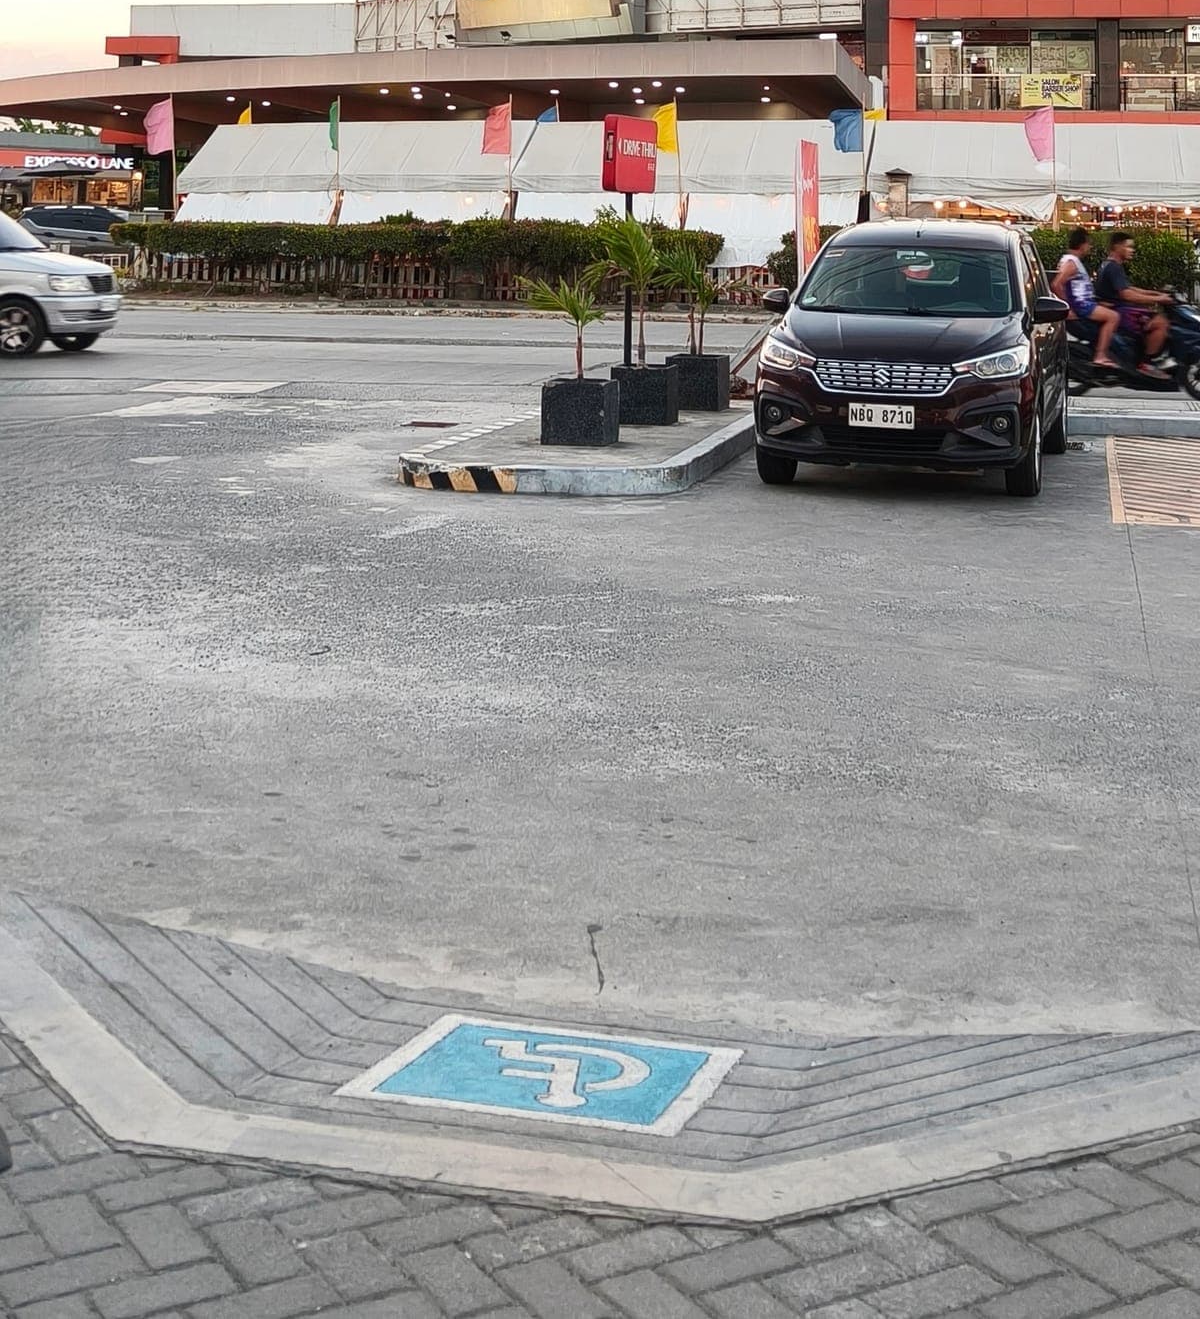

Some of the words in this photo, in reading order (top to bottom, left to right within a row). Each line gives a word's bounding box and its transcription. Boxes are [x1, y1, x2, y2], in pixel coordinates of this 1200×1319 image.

[623, 139, 640, 157] DRIVE
[101, 157, 135, 170] LANE
[850, 407, 873, 422] NBQ
[882, 409, 913, 425] 8710
